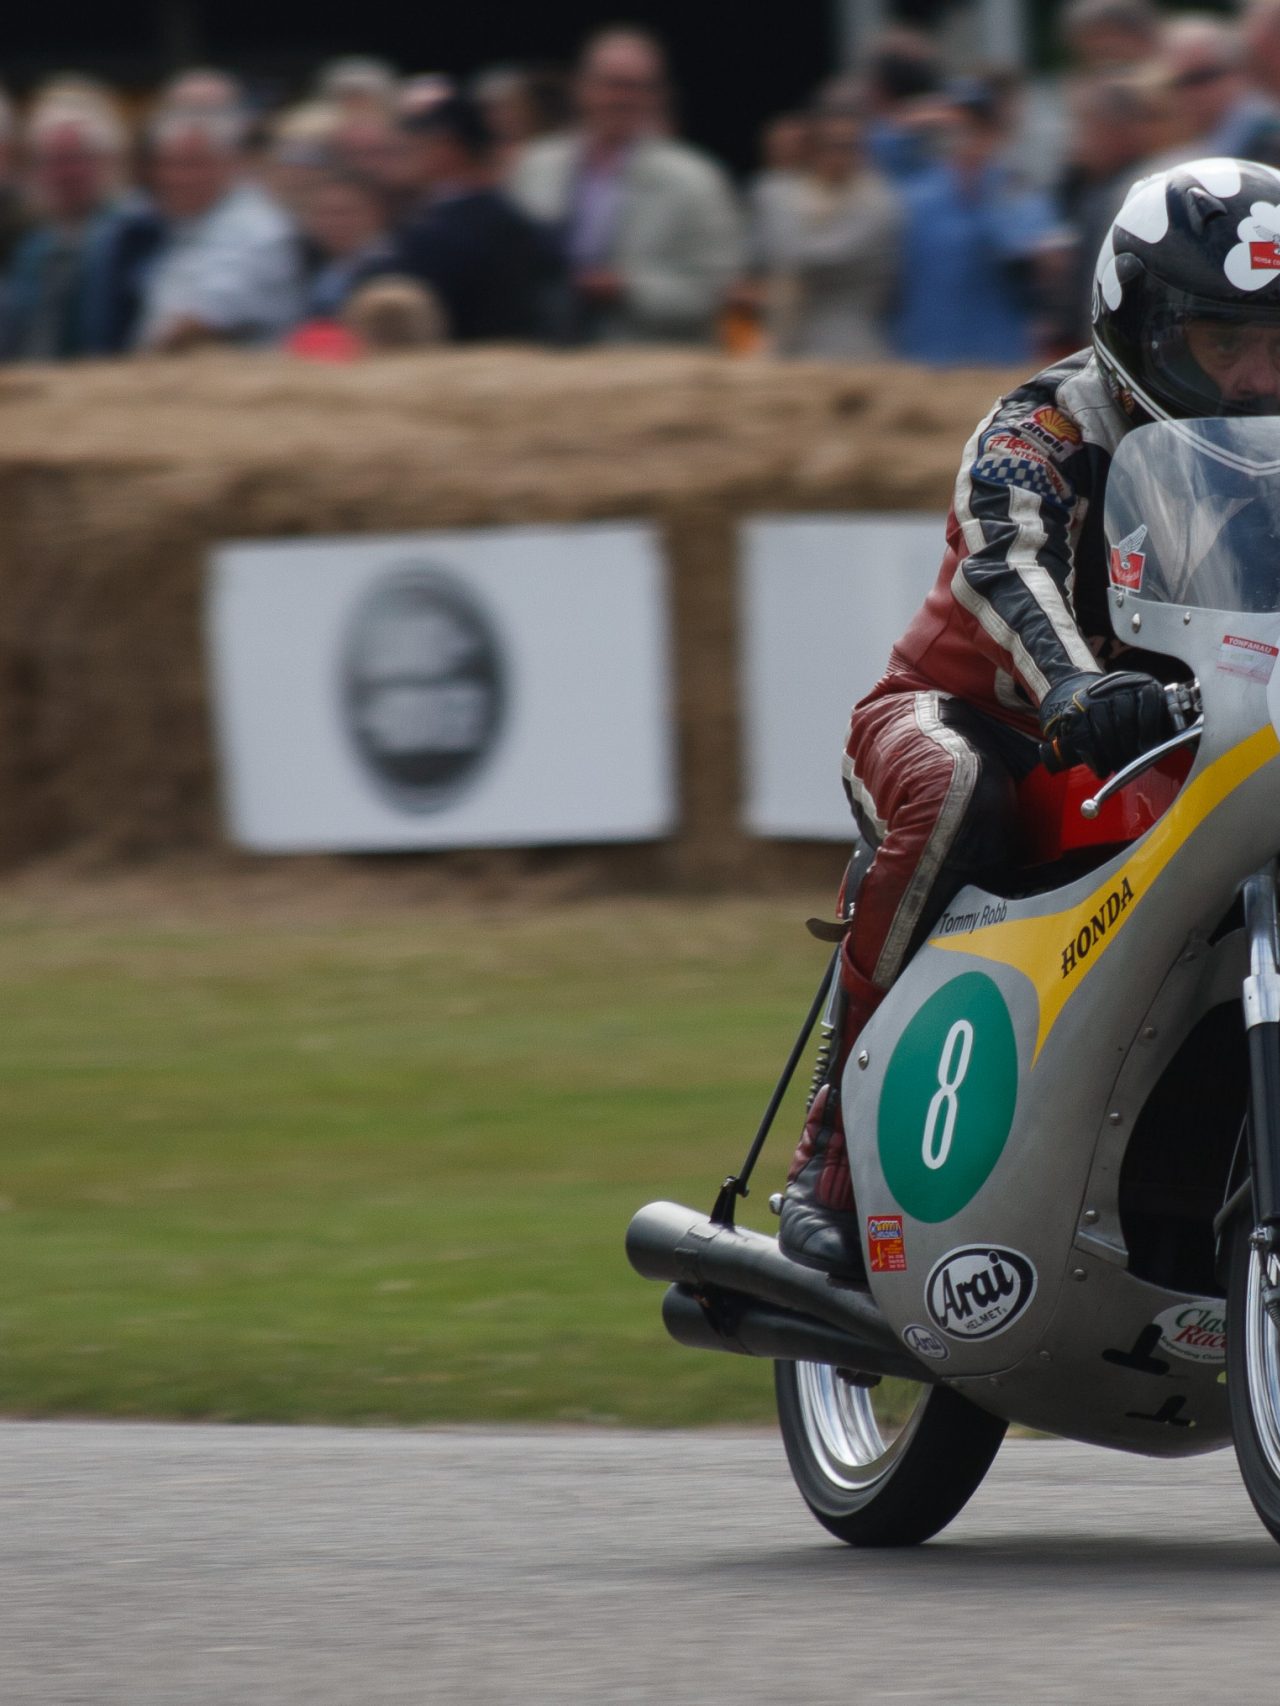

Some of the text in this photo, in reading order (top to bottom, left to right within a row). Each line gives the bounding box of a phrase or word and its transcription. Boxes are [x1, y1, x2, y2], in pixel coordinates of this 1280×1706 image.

[939, 900, 1008, 935] Tommy Robb
[1061, 876, 1134, 979] HONDA
[921, 1018, 974, 1170] 8
[938, 1251, 1014, 1328] Arai
[911, 1330, 942, 1351] Arai
